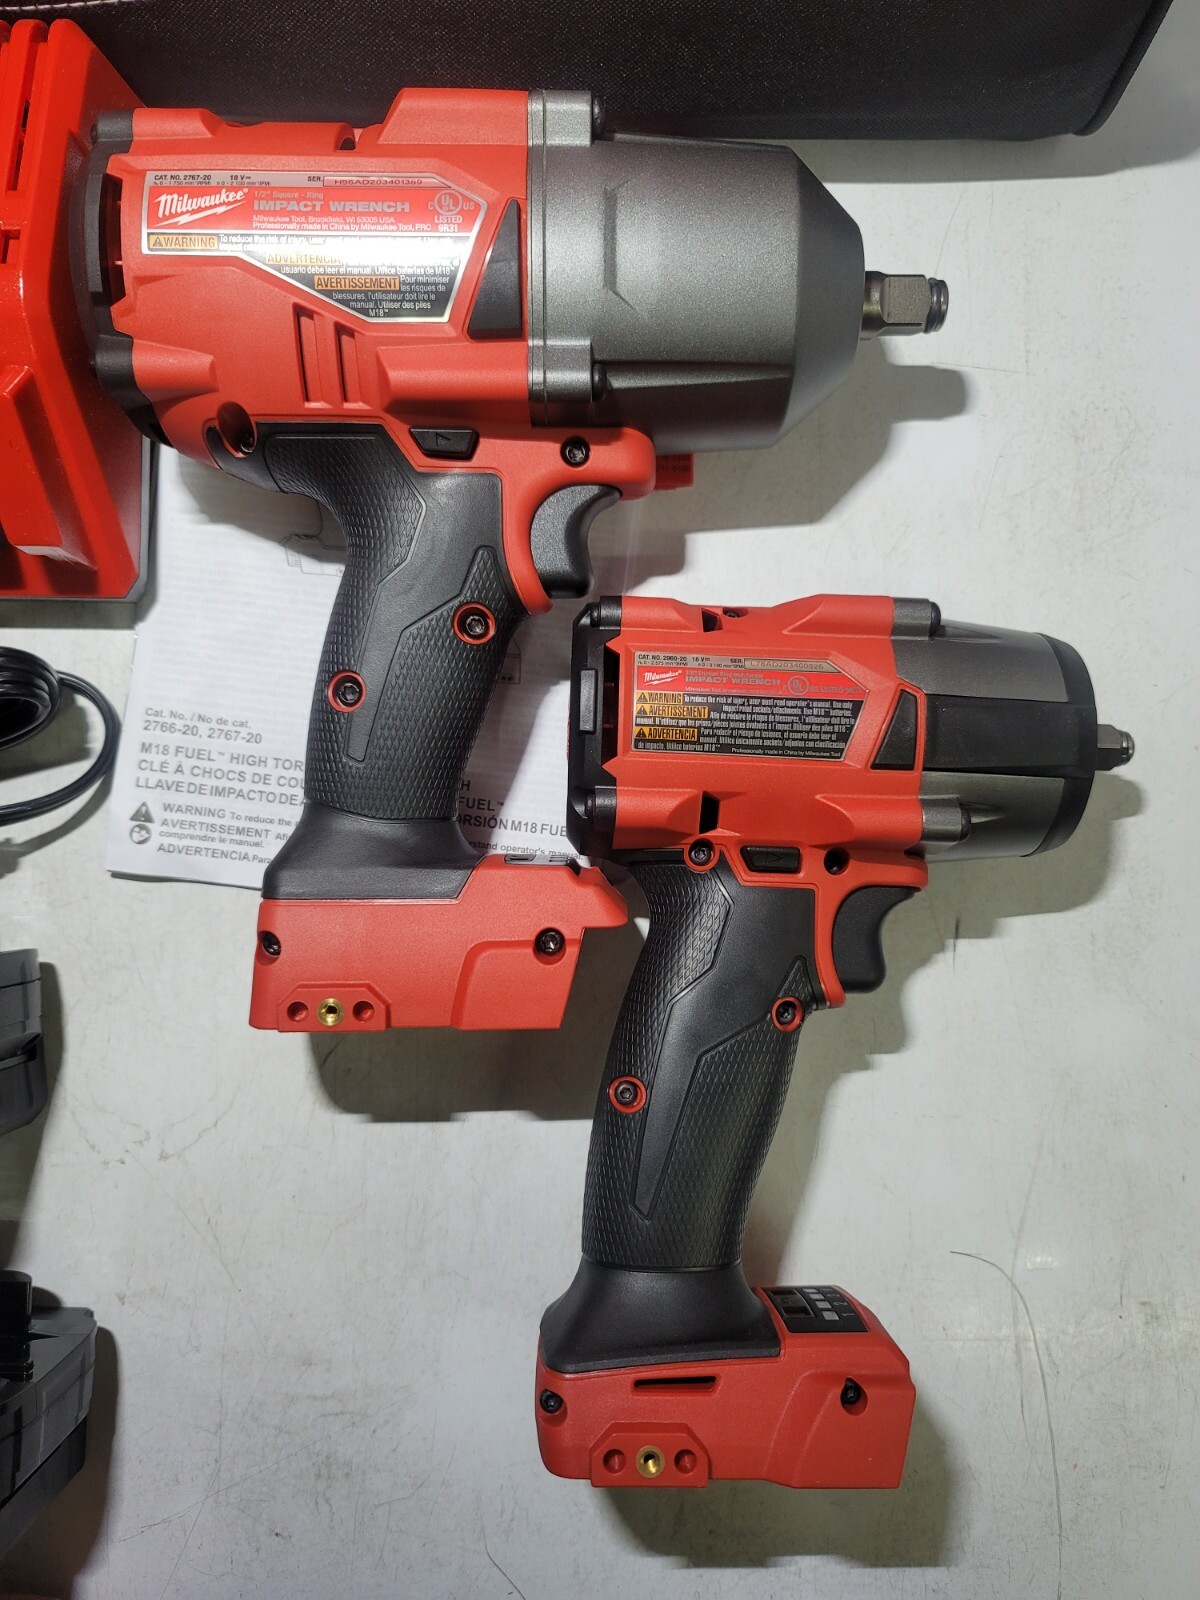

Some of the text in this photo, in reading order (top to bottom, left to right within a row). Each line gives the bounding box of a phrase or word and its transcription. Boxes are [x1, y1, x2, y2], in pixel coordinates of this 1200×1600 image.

[272, 191, 299, 199] Square
[306, 192, 324, 200] Ring
[253, 200, 410, 212] IMPACT WRENCH
[253, 222, 300, 230] Professionally
[350, 224, 360, 232] by
[164, 237, 215, 248] WARNING
[426, 267, 434, 275] de
[316, 276, 450, 290] AVERTISSEMENT Pour minimiser
[411, 284, 436, 294] risques
[332, 292, 367, 300] blessures,
[418, 292, 428, 300] lire
[378, 302, 401, 310] Utiliser
[415, 302, 431, 311] piles
[686, 676, 781, 686] IMPACT WRENCH
[648, 692, 682, 704] WARNING
[146, 707, 166, 718] Cat.
[170, 710, 188, 720] No.
[198, 714, 212, 724] No
[216, 716, 229, 726] de
[232, 718, 252, 728] cat.
[649, 705, 707, 718] AVERTISSEMENT
[143, 720, 262, 744] 2766-20, 2767-20
[648, 728, 696, 740] ADVERTENCIA
[140, 742, 170, 756] M18
[230, 753, 268, 768] HIGH
[138, 760, 170, 774] CLÉ
[174, 762, 186, 776] À
[190, 767, 247, 783] CHOCS
[252, 772, 272, 786] DE
[136, 777, 184, 792] LLAVE
[188, 782, 208, 796] DE
[210, 786, 277, 804] IMPACTO
[278, 793, 299, 806] DE
[162, 803, 226, 819] WARNING
[230, 812, 242, 821] To
[244, 814, 275, 826] reduce
[278, 818, 292, 827] the
[160, 818, 271, 840] AVERTISSEMENT
[510, 820, 538, 834] M18
[159, 831, 265, 849] comprendre le manuel.
[157, 843, 250, 862] ADVERTENCIA
[500, 844, 546, 855] operator's
